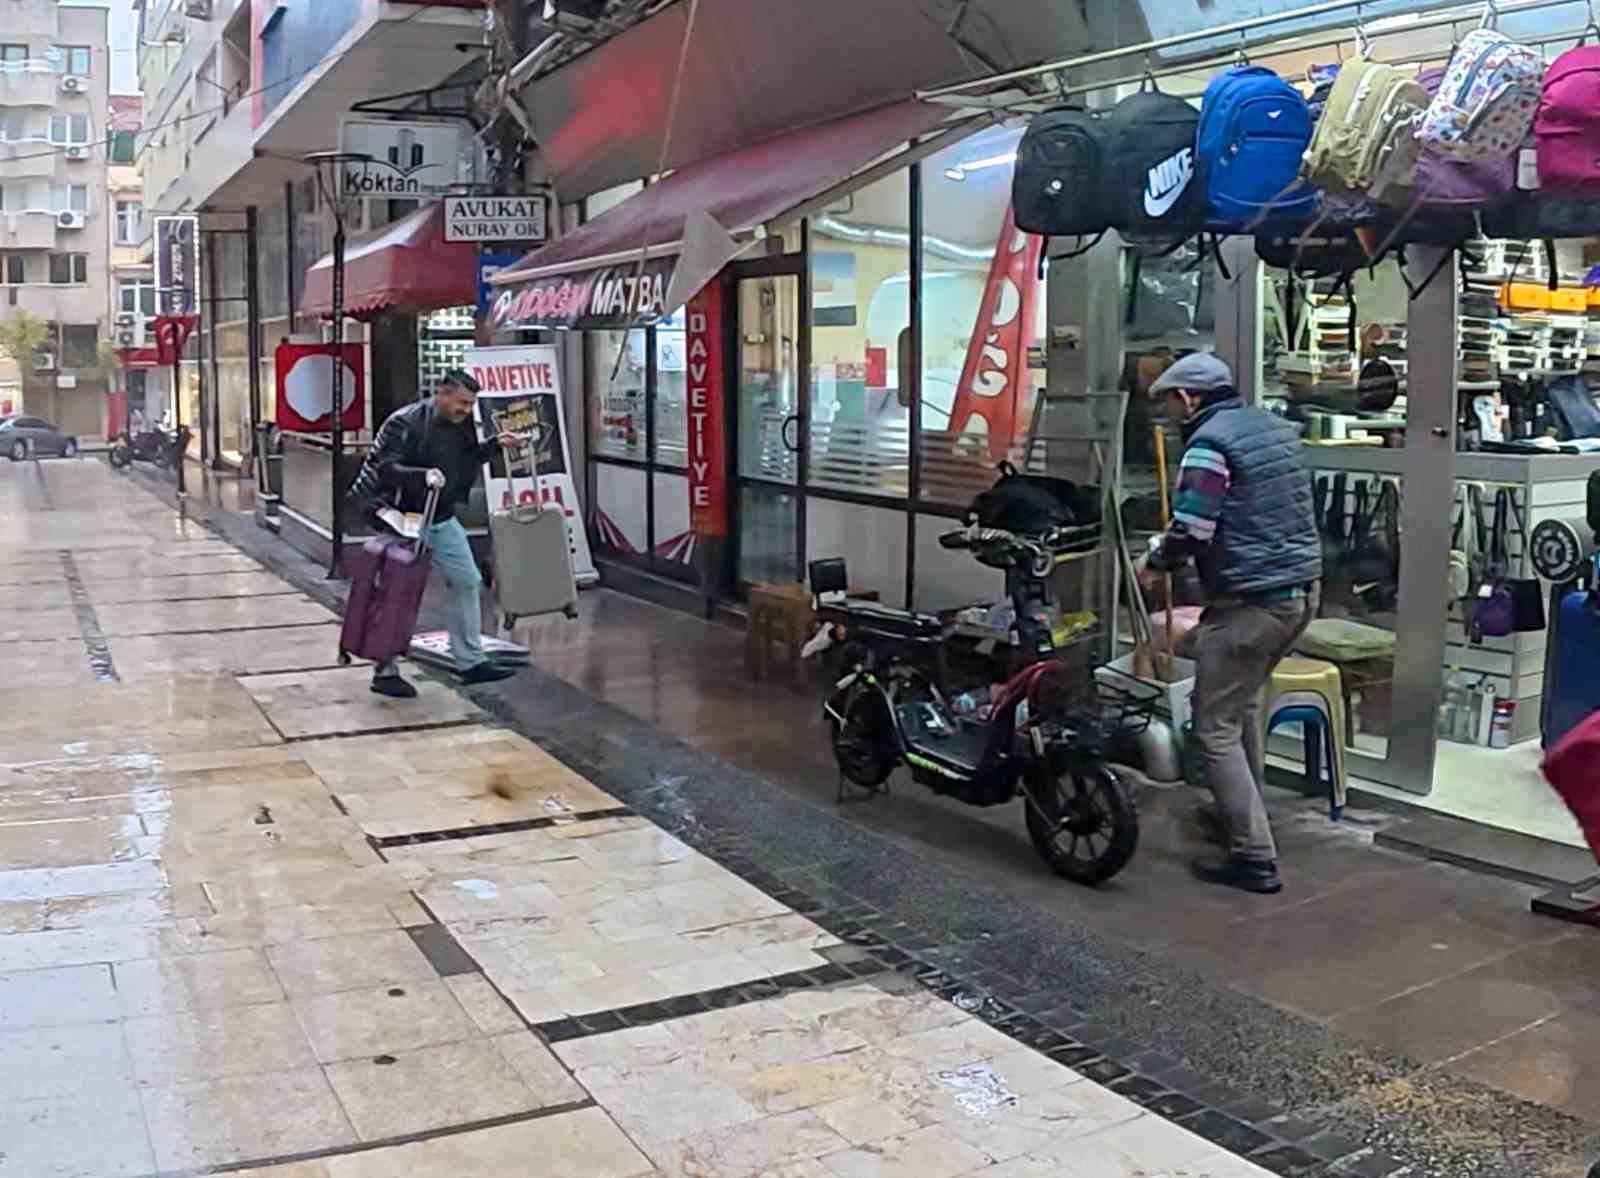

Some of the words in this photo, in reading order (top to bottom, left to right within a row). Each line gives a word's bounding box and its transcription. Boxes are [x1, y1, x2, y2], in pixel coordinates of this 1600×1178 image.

[1148, 147, 1194, 198] NIKE
[452, 201, 538, 218] AVUKAT
[452, 223, 510, 236] NURAY
[514, 222, 539, 236] OK
[473, 359, 553, 392] DAVETİYE
[688, 313, 711, 507] DAVETİYE
